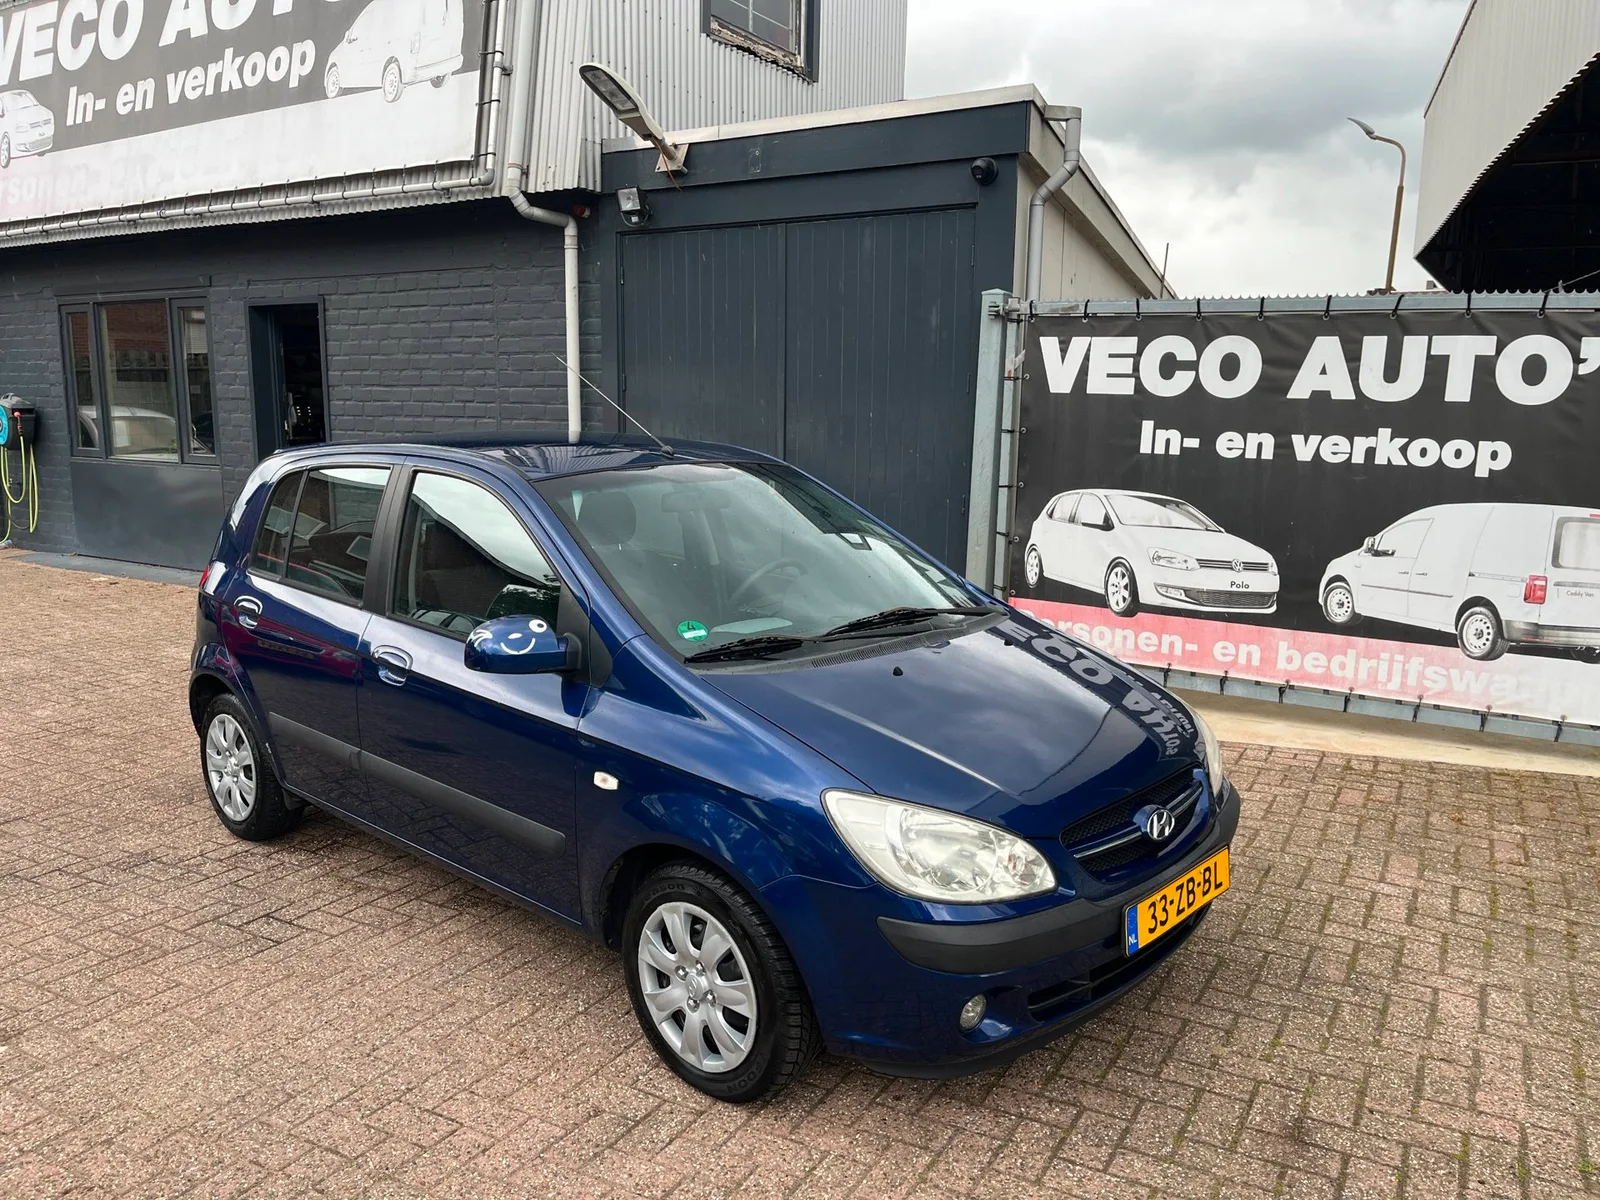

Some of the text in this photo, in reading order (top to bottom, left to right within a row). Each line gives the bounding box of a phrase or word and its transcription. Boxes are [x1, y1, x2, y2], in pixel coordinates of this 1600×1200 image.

[0, 0, 144, 86] VECO
[66, 40, 316, 127] In- en verkoop
[1040, 335, 1262, 398] VECO
[1140, 420, 1512, 477] In- en verkoop
[1230, 581, 1250, 589] Polo
[1213, 641, 1261, 667] en
[1148, 861, 1223, 934] 33-ZB-BL
[1128, 933, 1138, 946] NL
